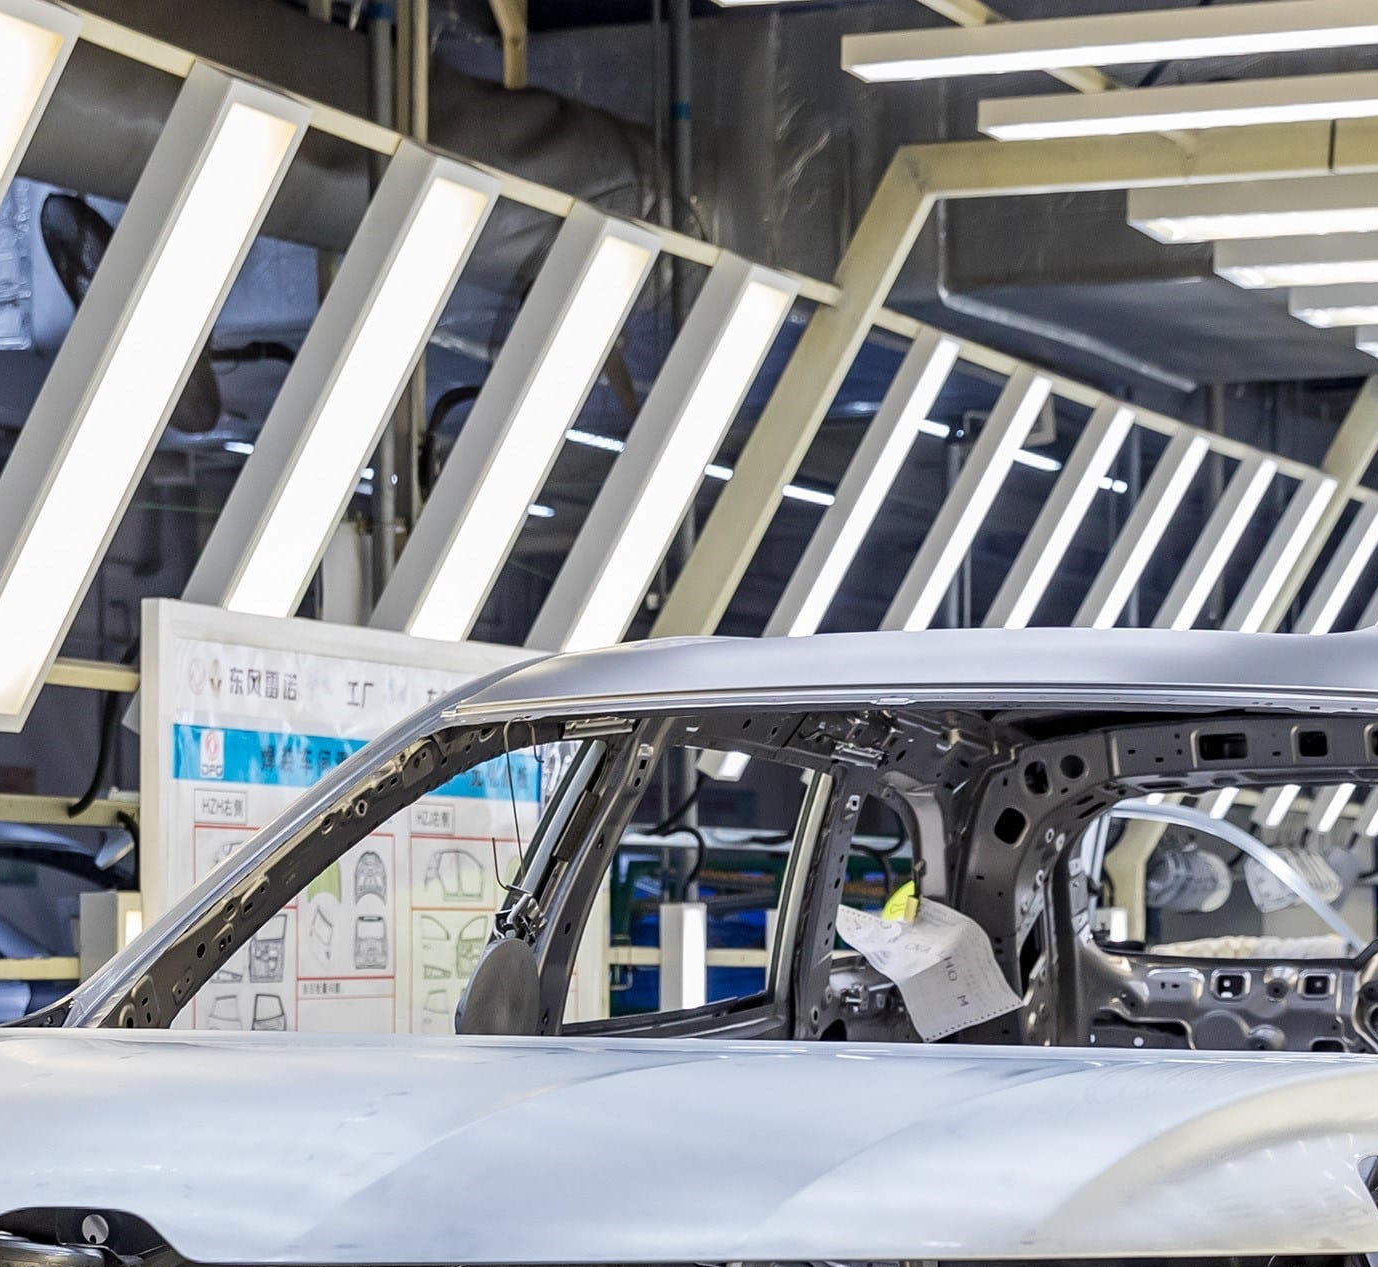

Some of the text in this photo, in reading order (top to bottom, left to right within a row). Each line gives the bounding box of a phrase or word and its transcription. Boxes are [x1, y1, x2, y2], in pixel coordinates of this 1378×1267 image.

[229, 667, 375, 708] 东风雷诺 工厂
